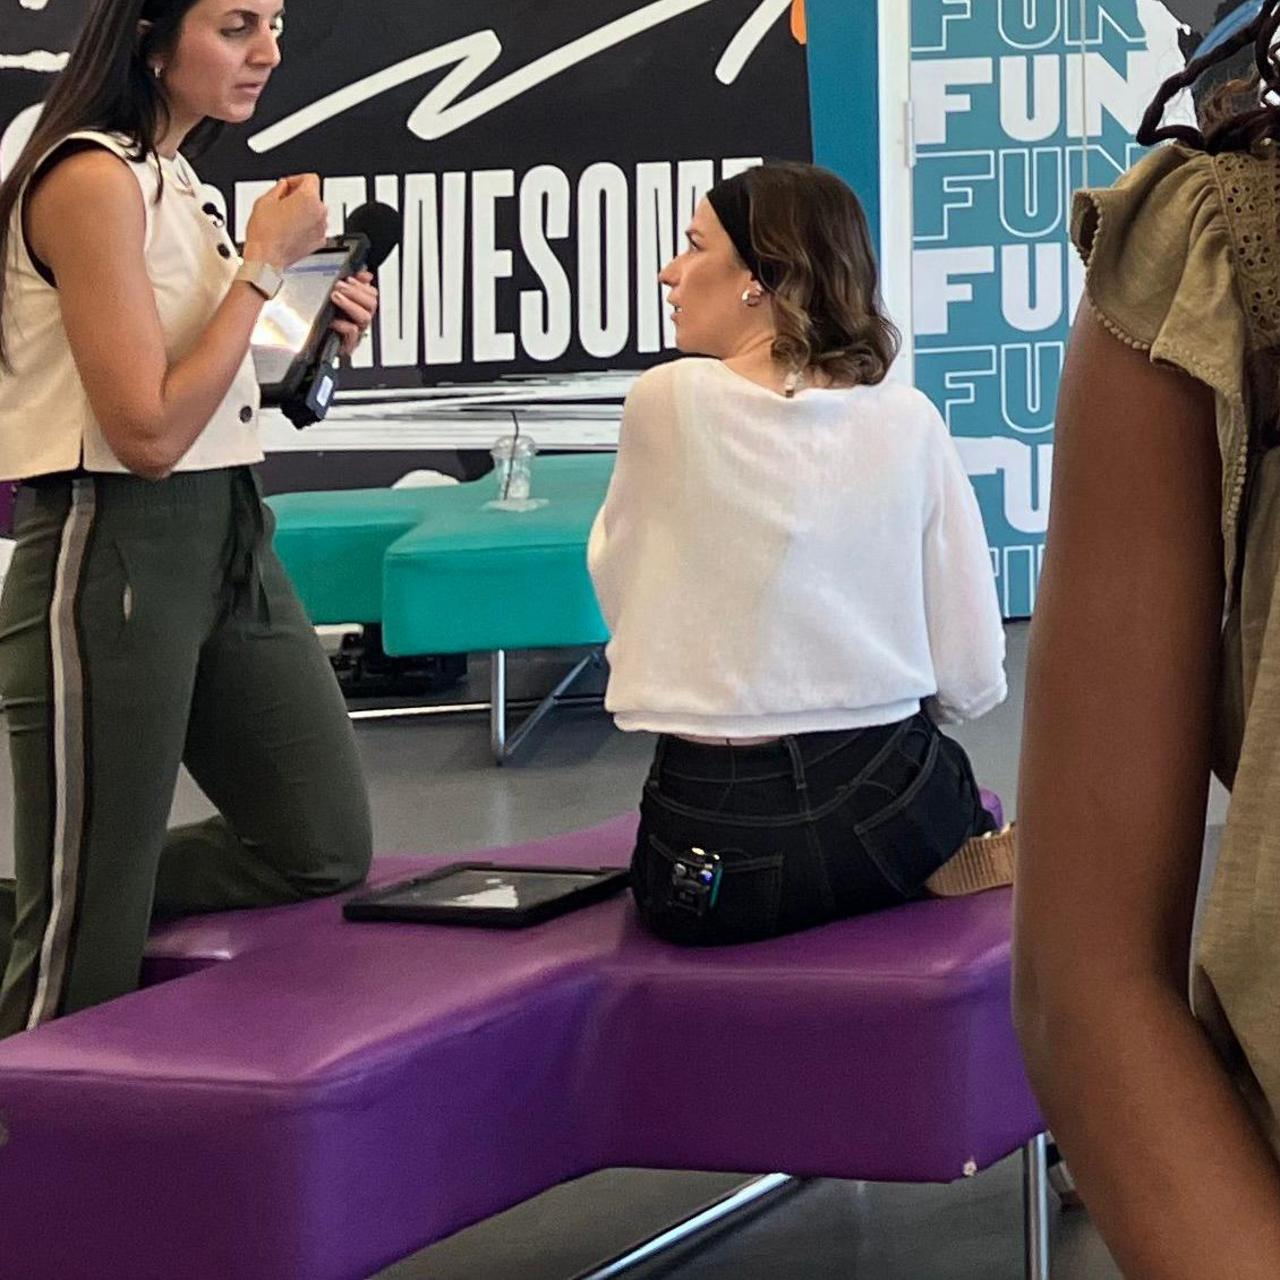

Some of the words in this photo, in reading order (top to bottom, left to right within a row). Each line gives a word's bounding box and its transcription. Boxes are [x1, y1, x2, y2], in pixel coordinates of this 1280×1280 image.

[912, 52, 1148, 145] FUN
[324, 157, 763, 368] WESOM
[913, 243, 1087, 336] FU
